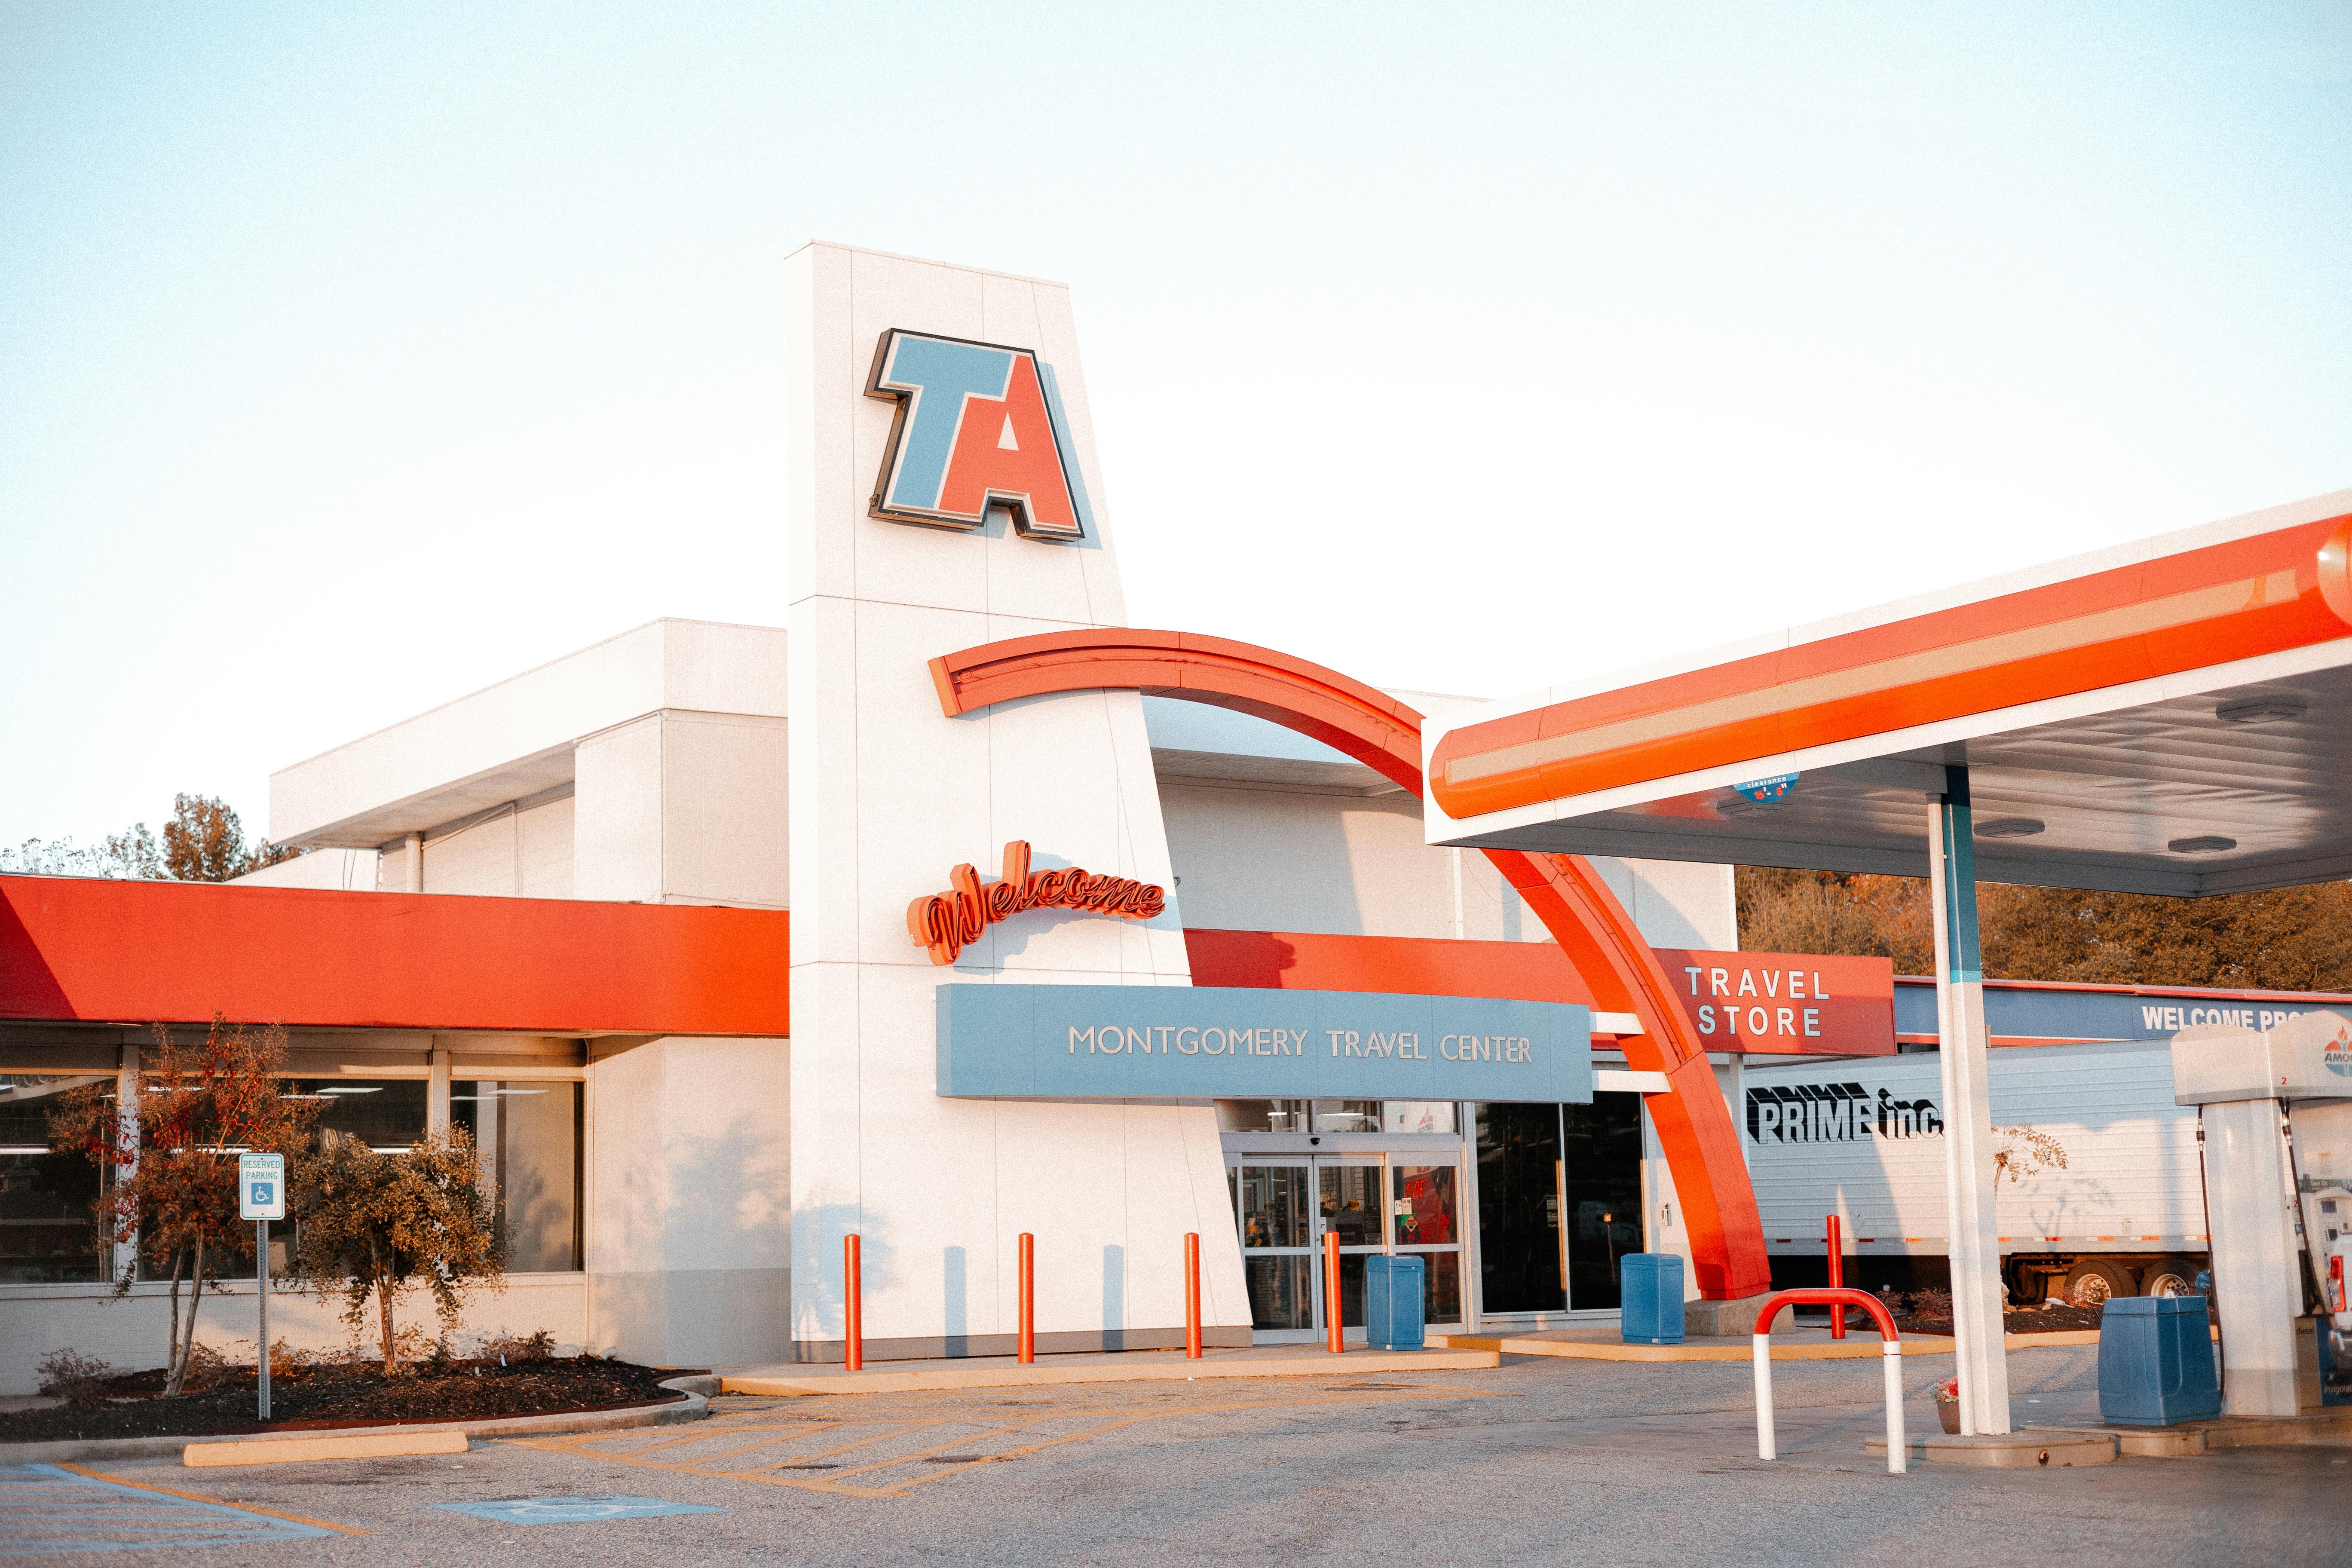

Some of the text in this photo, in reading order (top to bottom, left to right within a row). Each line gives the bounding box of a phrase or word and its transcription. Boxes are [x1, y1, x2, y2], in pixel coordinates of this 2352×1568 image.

[864, 328, 1085, 542] TA
[1747, 777, 1786, 788] clearance
[907, 840, 1165, 966] Welcome
[1684, 966, 1829, 1000] TRAVEL
[1698, 1004, 1821, 1037] STORE
[2141, 1006, 2255, 1031] WELCOME
[1069, 1026, 1531, 1063] MONTGOMERY TRAVEL CENTER
[2324, 1053, 2352, 1063] AMO
[1746, 1082, 1873, 1145] PRIME
[243, 1161, 280, 1169] RESERVED
[246, 1171, 278, 1179] PARKING
[2294, 1200, 2299, 1208] 2
